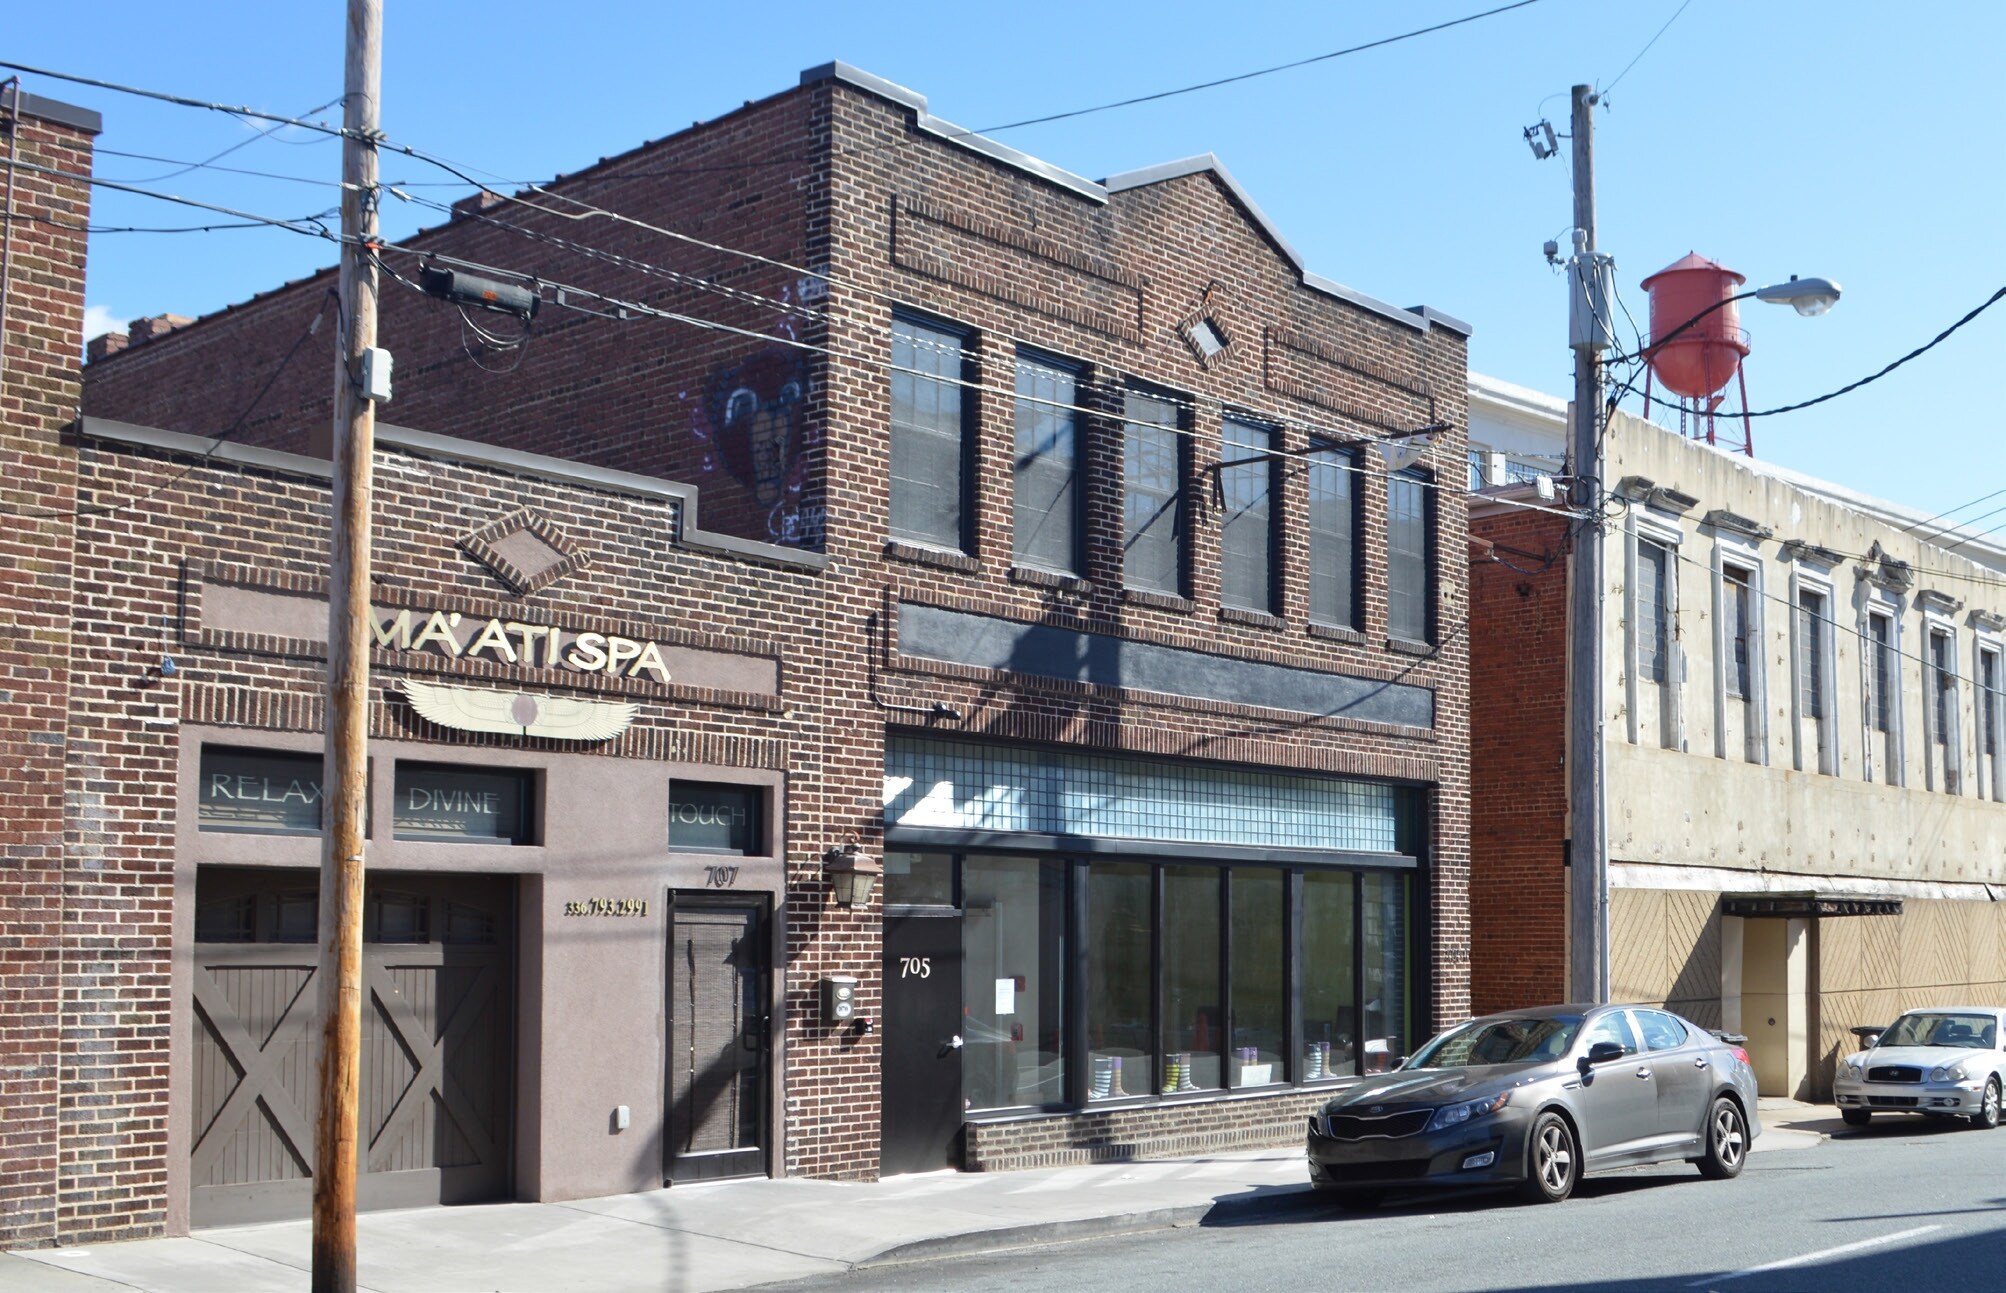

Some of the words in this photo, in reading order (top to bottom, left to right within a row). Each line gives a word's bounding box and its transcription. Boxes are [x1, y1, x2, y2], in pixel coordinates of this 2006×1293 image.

[568, 632, 671, 683] SPA
[212, 774, 325, 803] RELAX
[408, 787, 500, 814] DIVINE
[669, 802, 746, 826] TOUCH
[704, 865, 740, 888] 707
[567, 897, 650, 916] 336.793.2991
[900, 957, 931, 979] 705
